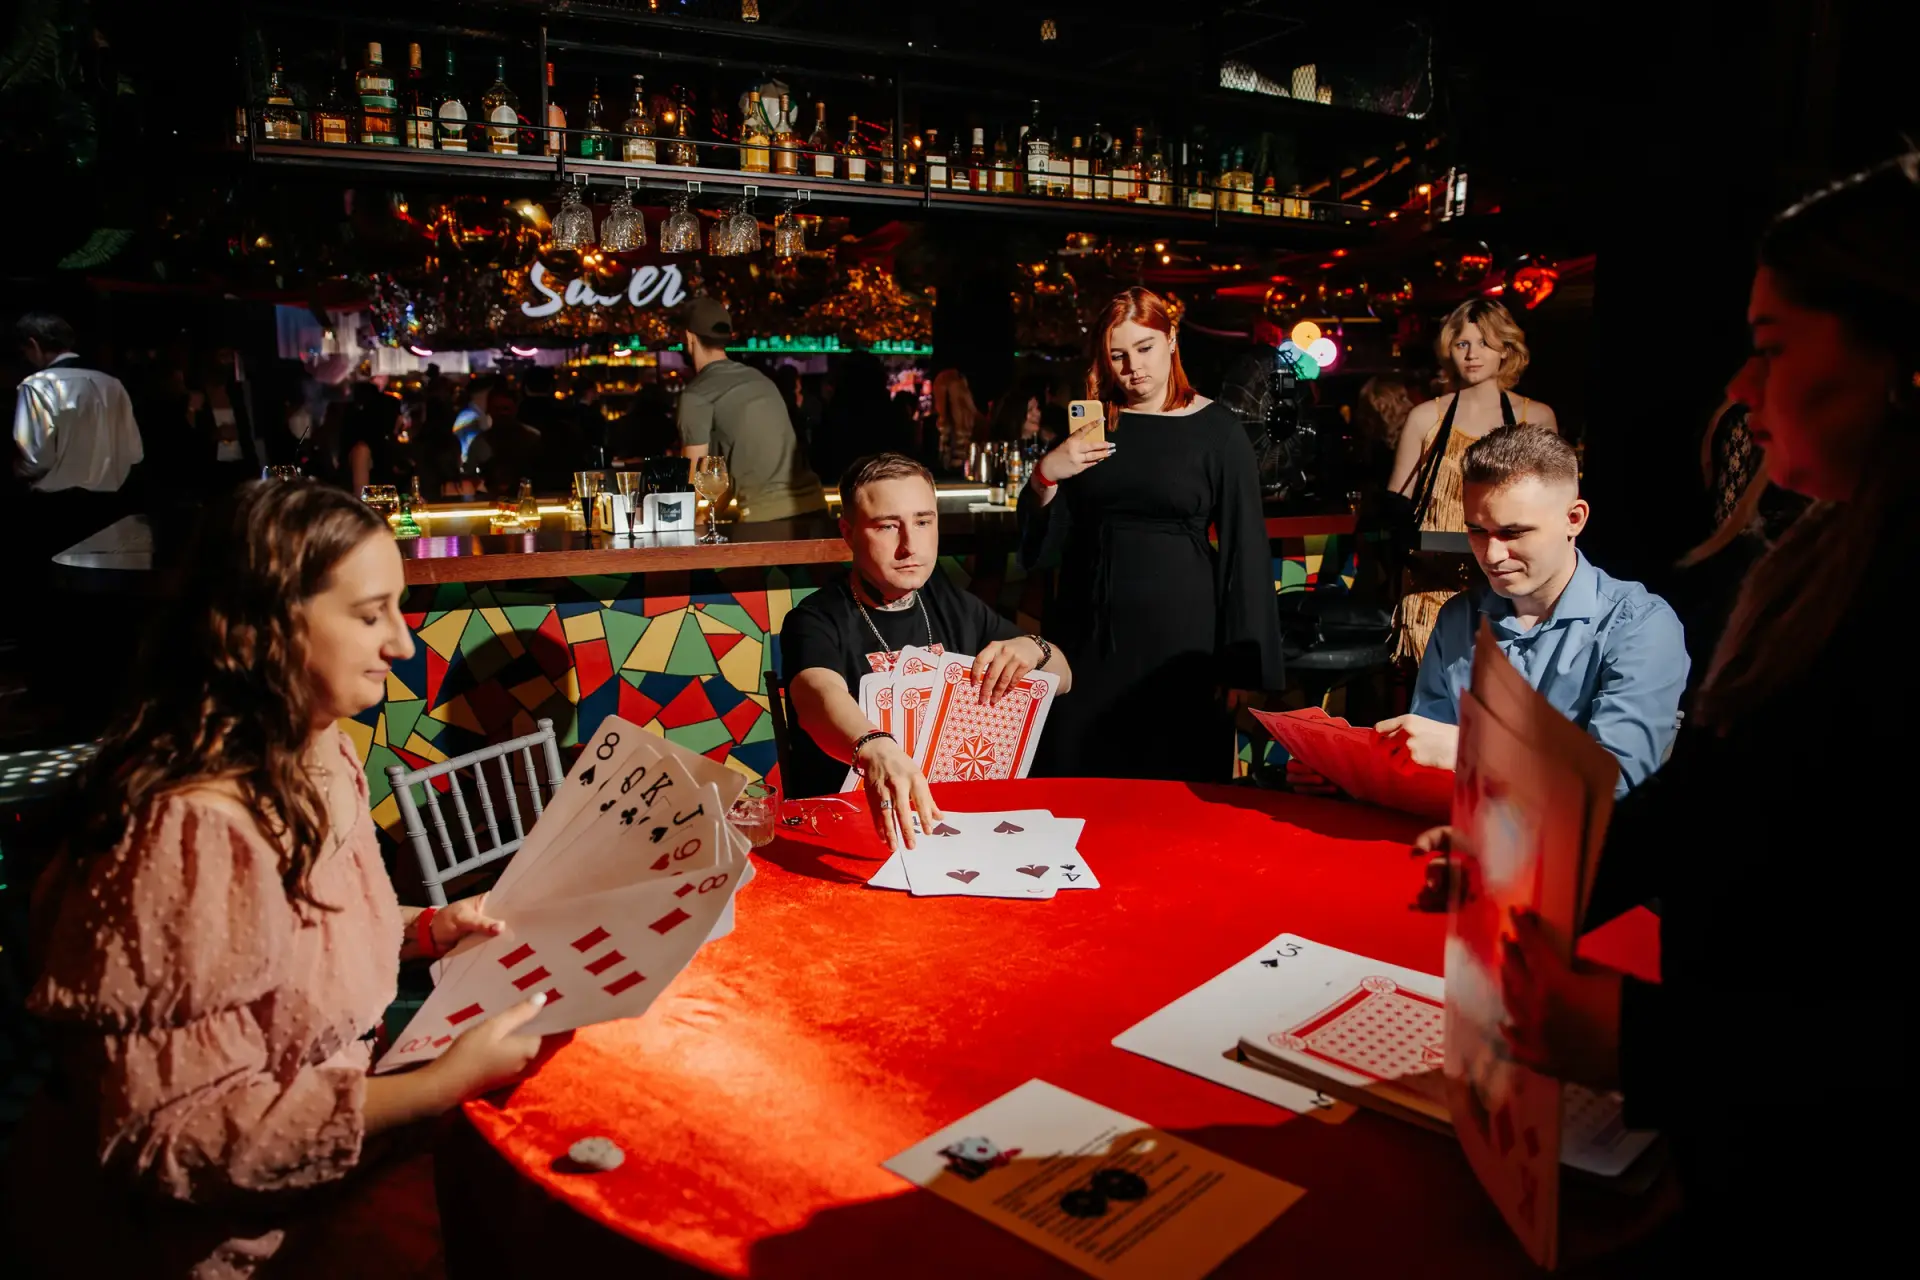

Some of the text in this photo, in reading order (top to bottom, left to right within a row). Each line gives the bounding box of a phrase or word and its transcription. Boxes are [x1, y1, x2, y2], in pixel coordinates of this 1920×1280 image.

[596, 732, 620, 760] 8
[621, 766, 646, 794] Q
[640, 772, 674, 807] K
[673, 804, 705, 826] J
[698, 873, 728, 894] 8
[1062, 872, 1081, 882] 4
[1276, 943, 1304, 958] 3
